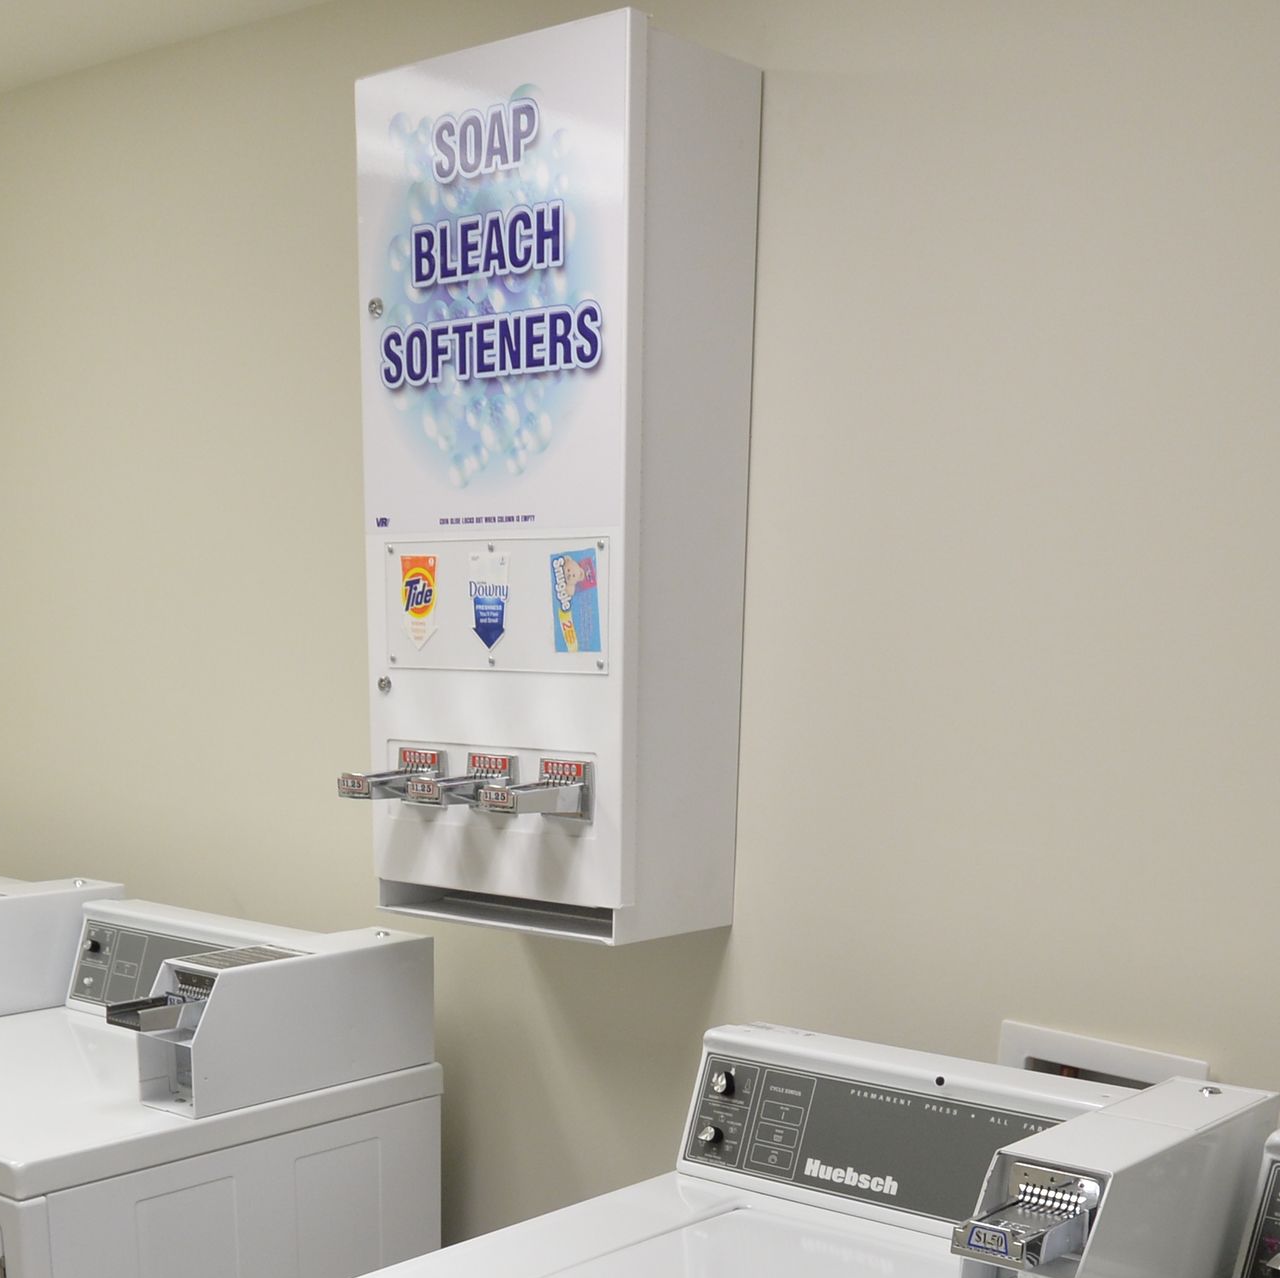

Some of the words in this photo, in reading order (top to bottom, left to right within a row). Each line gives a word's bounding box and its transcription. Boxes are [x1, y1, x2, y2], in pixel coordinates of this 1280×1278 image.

[433, 101, 538, 181] SOAP
[413, 203, 563, 284] BLEACH
[382, 304, 600, 385] SOFTENERS
[405, 578, 433, 612] Tide
[469, 581, 509, 601] Downy
[552, 556, 572, 611] Snuggle
[850, 1088, 912, 1107] PERMANENT
[924, 1103, 959, 1116] PRESS
[988, 1116, 1009, 1126] ALL
[1022, 1122, 1049, 1132] FAB
[804, 1157, 899, 1196] Huebsch
